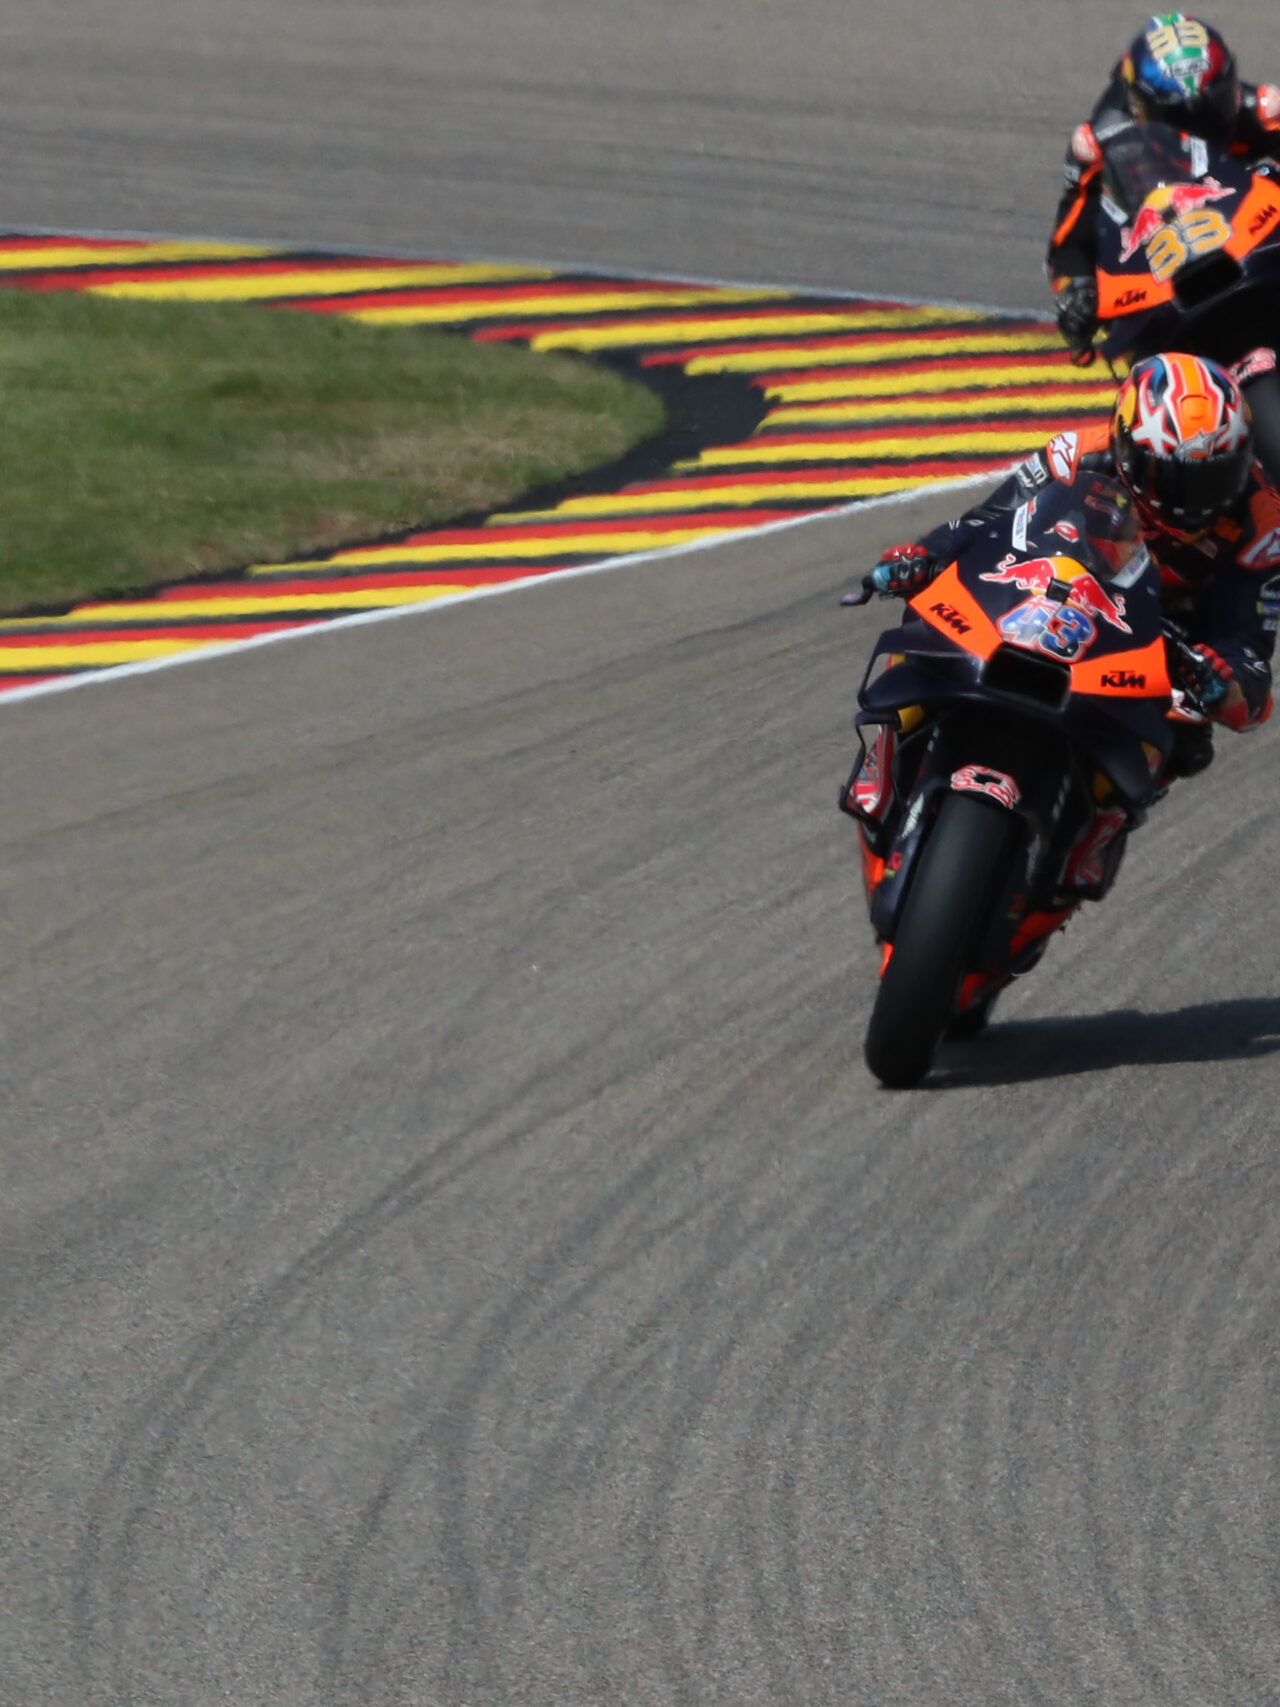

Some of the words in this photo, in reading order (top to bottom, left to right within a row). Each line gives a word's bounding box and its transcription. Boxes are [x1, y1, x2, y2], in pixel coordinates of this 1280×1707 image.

[1249, 204, 1277, 238] KTM
[1145, 208, 1232, 284] 33
[1114, 289, 1147, 308] KTM
[929, 602, 973, 635] KTM
[1101, 669, 1146, 689] KTM
